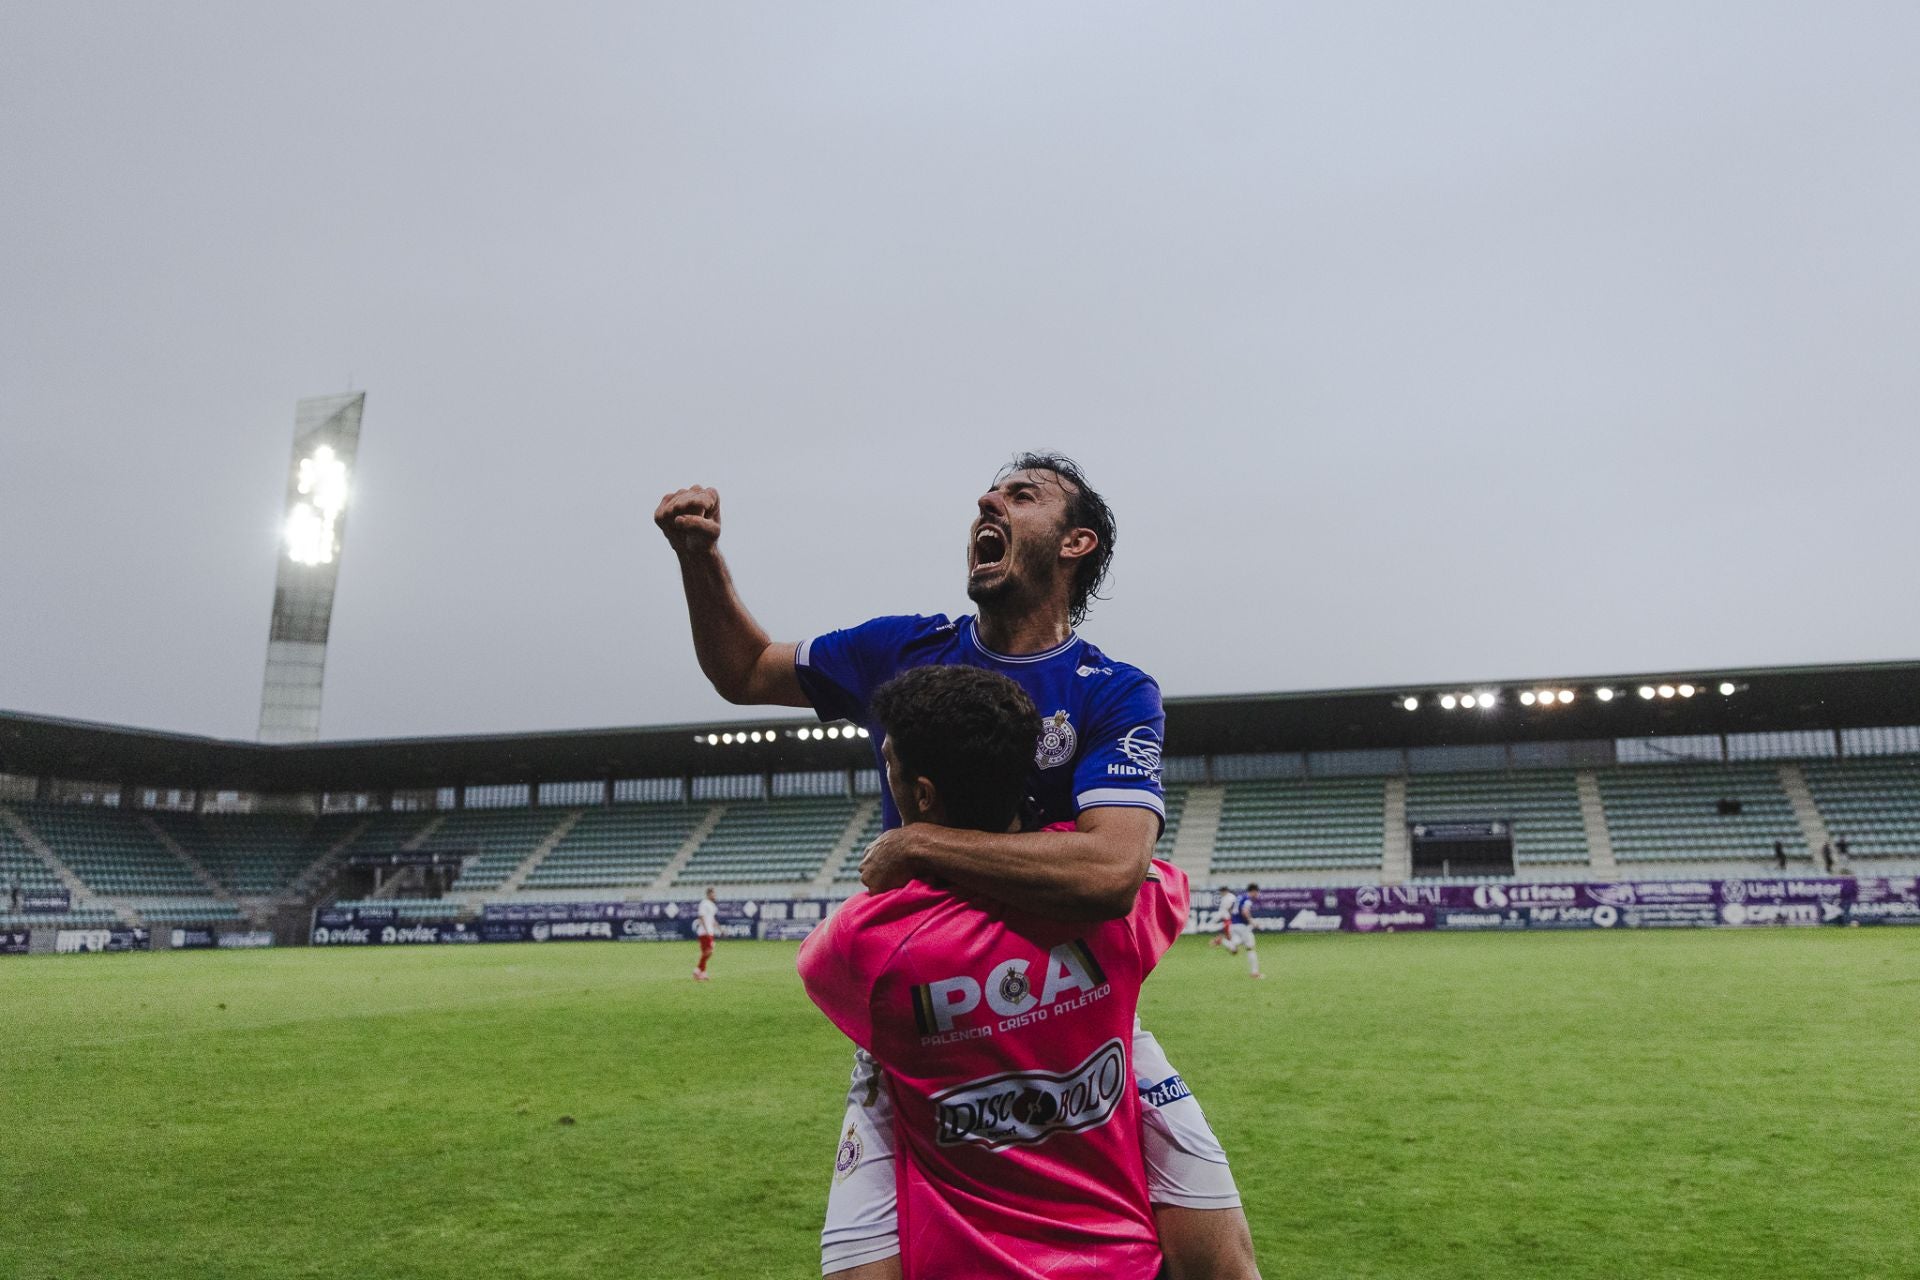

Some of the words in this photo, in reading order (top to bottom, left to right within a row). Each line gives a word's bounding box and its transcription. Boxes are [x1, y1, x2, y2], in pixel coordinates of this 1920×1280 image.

[1107, 763, 1163, 786] HIDIFE
[921, 1024, 993, 1047] PALENCIA
[998, 1010, 1048, 1033] CRISTO
[1054, 983, 1111, 1017] ATLÉTICO
[929, 943, 1095, 1032] PCA
